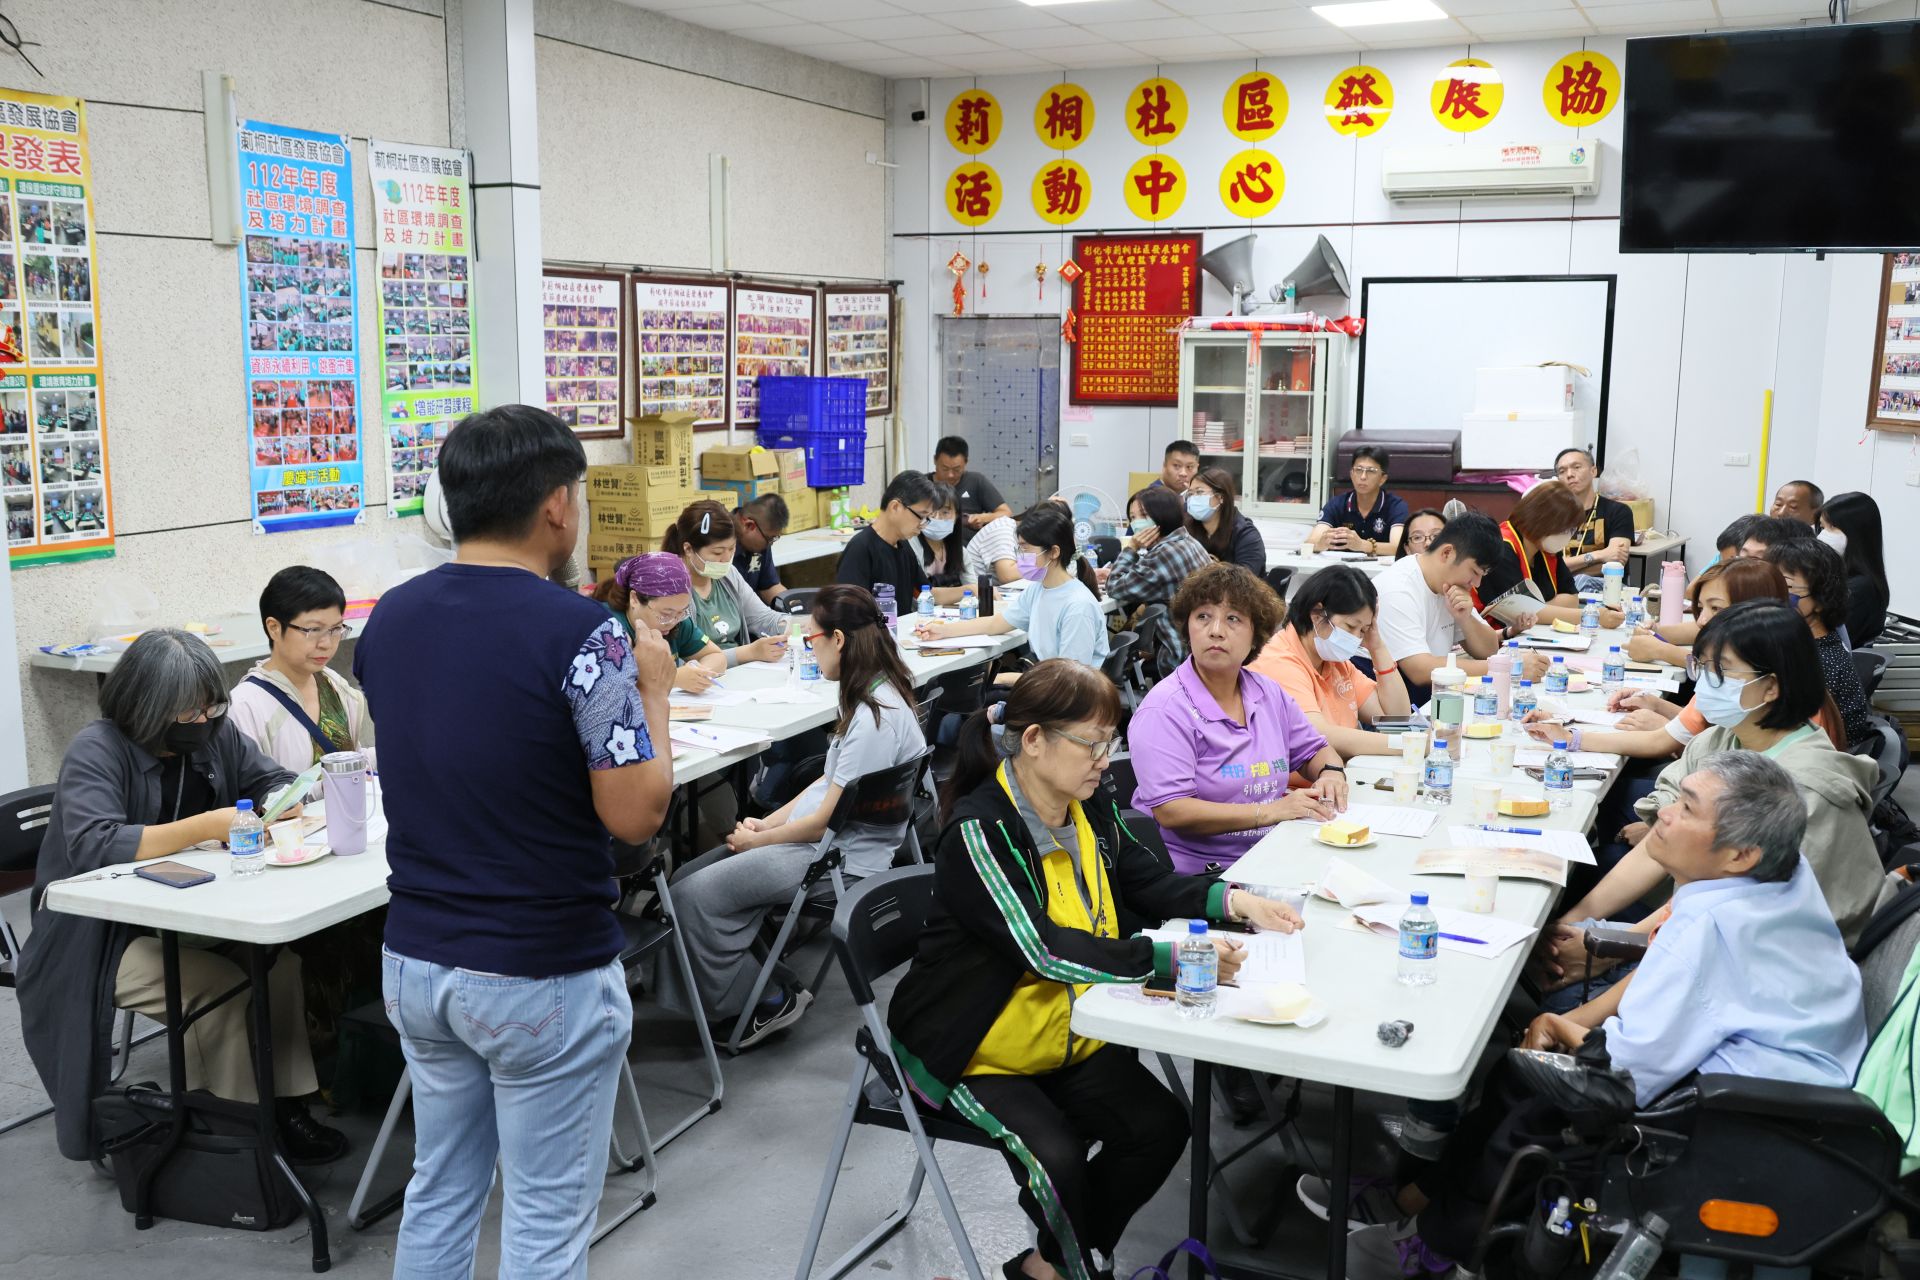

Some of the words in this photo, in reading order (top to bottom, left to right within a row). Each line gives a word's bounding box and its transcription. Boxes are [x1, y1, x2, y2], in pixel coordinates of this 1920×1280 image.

[249, 162, 337, 196] 112年年度
[247, 190, 345, 217] 社區環境調查
[402, 182, 461, 208] 112年年度
[383, 208, 463, 230] 社區環境調查
[282, 467, 341, 486] 慶端午活動
[593, 477, 618, 489] 林世賢
[598, 513, 623, 525] 林世賢
